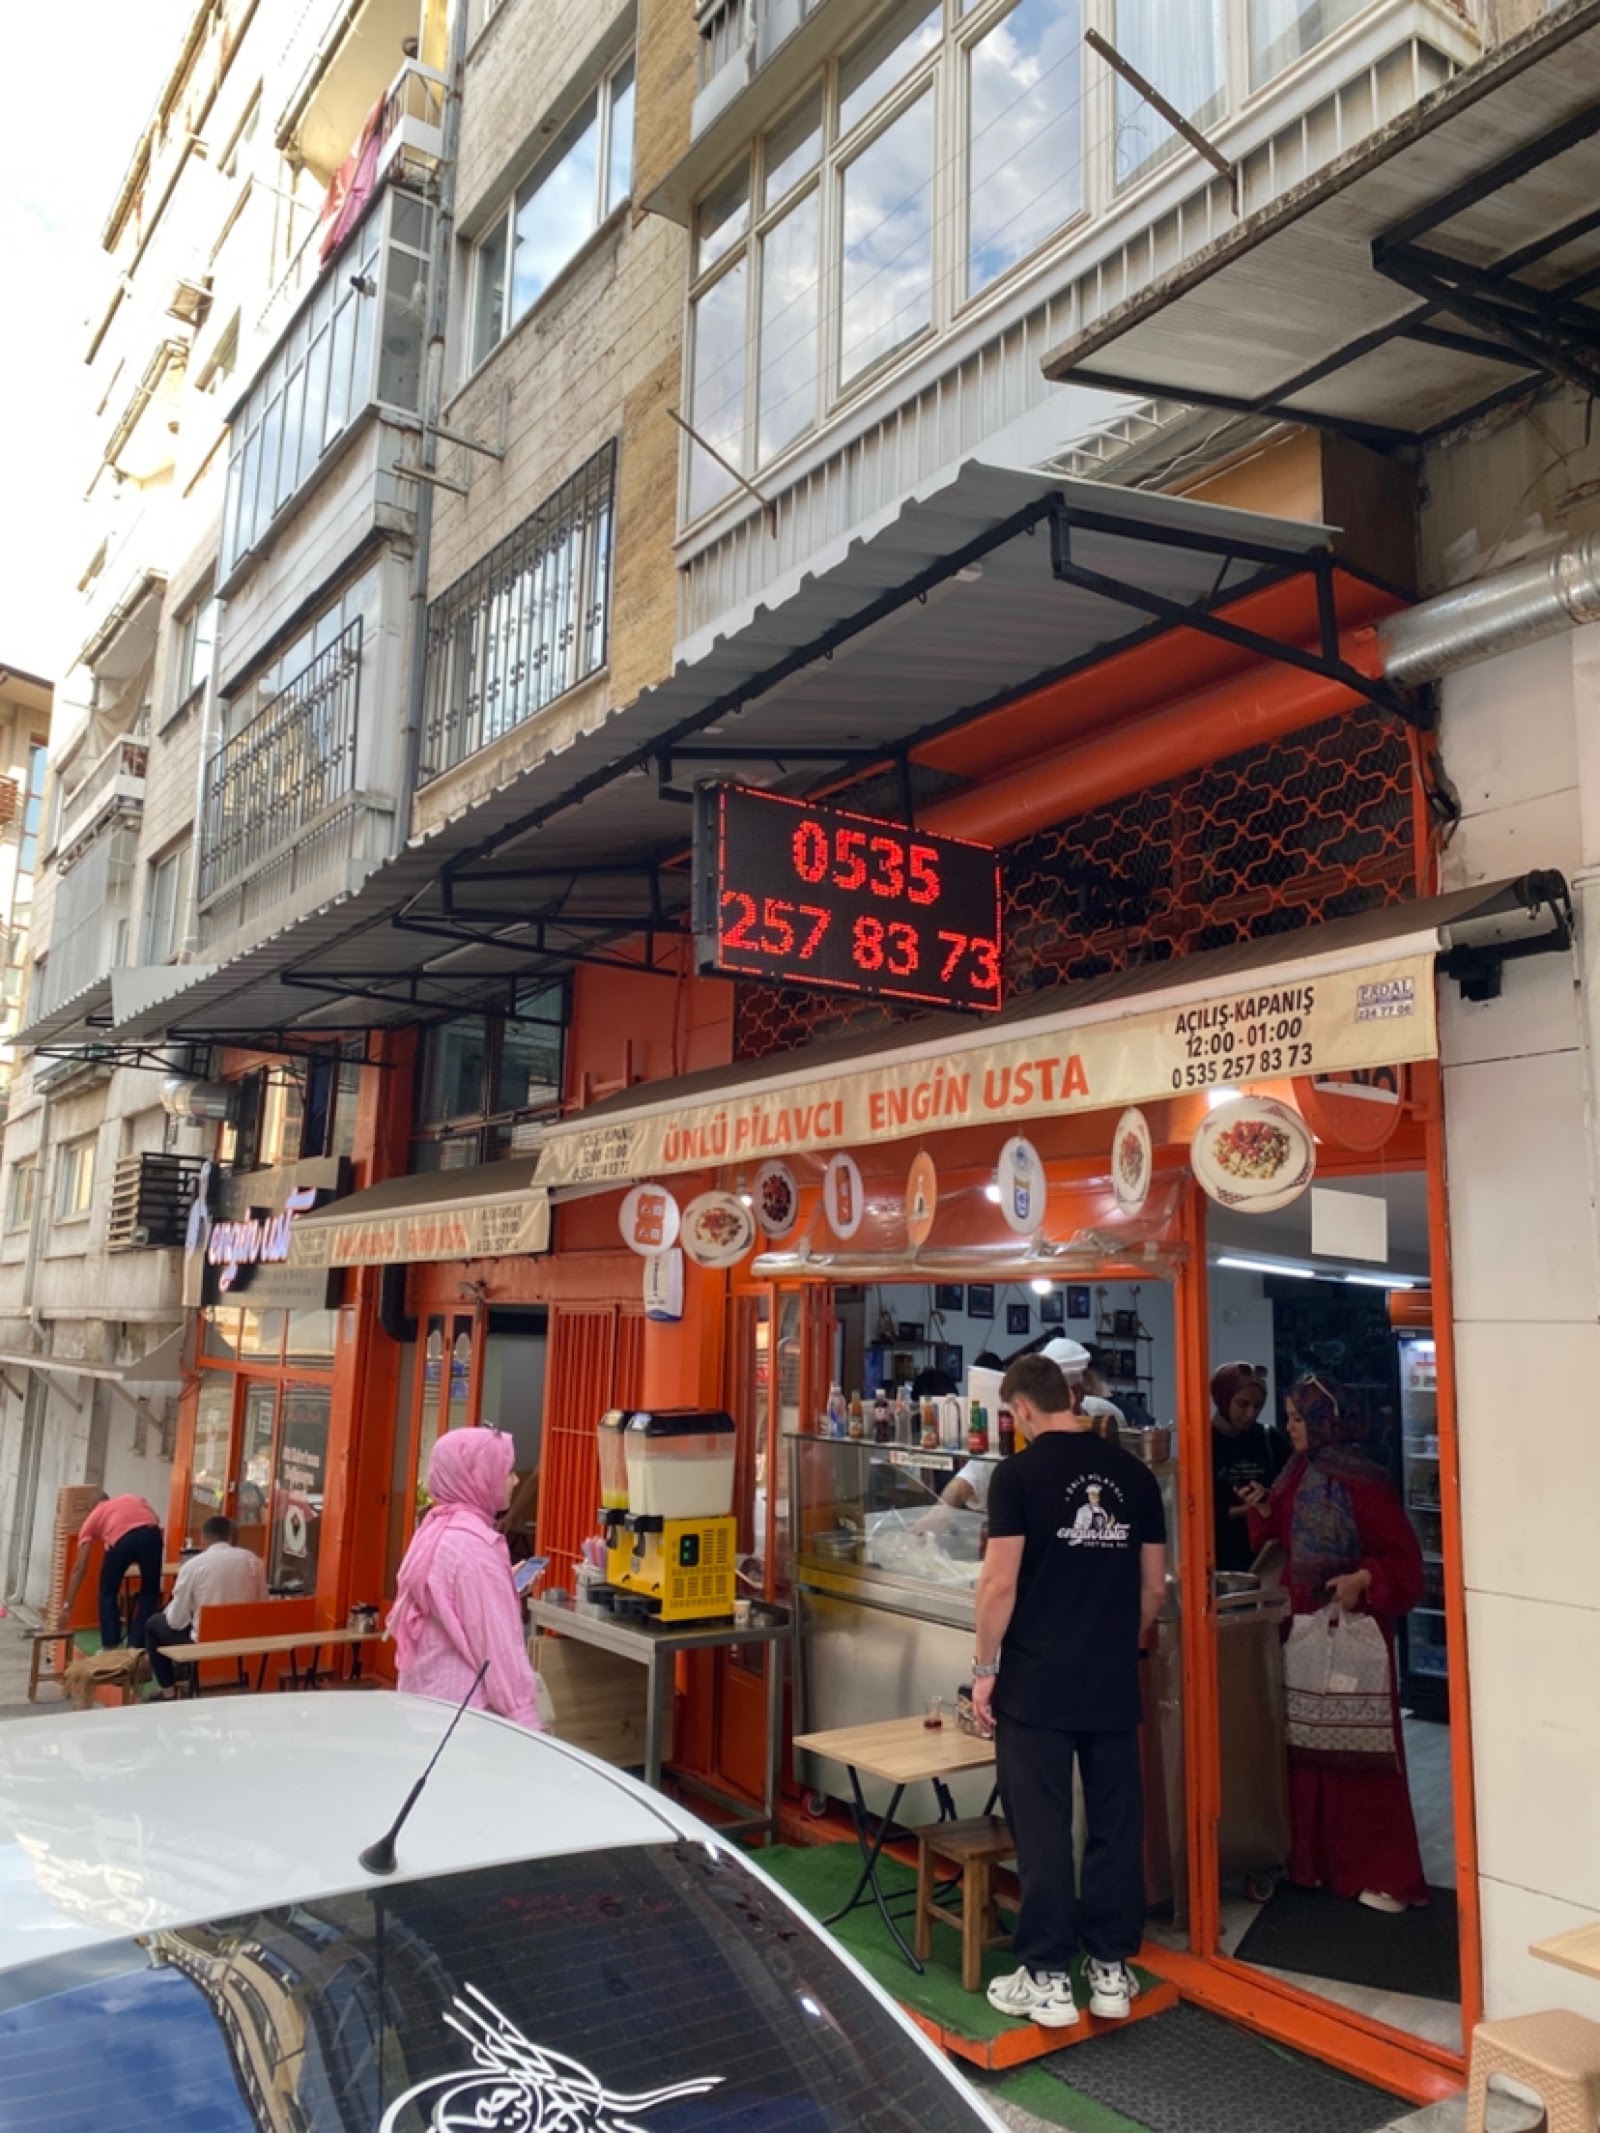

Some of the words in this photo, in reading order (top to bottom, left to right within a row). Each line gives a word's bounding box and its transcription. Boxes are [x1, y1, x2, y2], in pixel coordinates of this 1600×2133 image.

[792, 820, 940, 906] 0535
[720, 890, 832, 959] 257
[853, 915, 919, 976] 83
[938, 930, 1001, 990] 73
[1175, 986, 1315, 1035] AÇILIŞ-KAPANIŞ
[1186, 1031, 1235, 1058] 12:00
[1247, 1017, 1303, 1047] 01:00
[1172, 1068, 1182, 1089] 0
[1186, 1060, 1217, 1087] 535
[1222, 1054, 1256, 1080] 257
[1260, 1047, 1282, 1073] 83
[1289, 1042, 1313, 1068] 73
[663, 1112, 728, 1163] ÜNLÜ
[734, 1099, 843, 1151] PİLAVCI
[869, 1067, 970, 1131] ENGİN
[983, 1054, 1090, 1110] USTA
